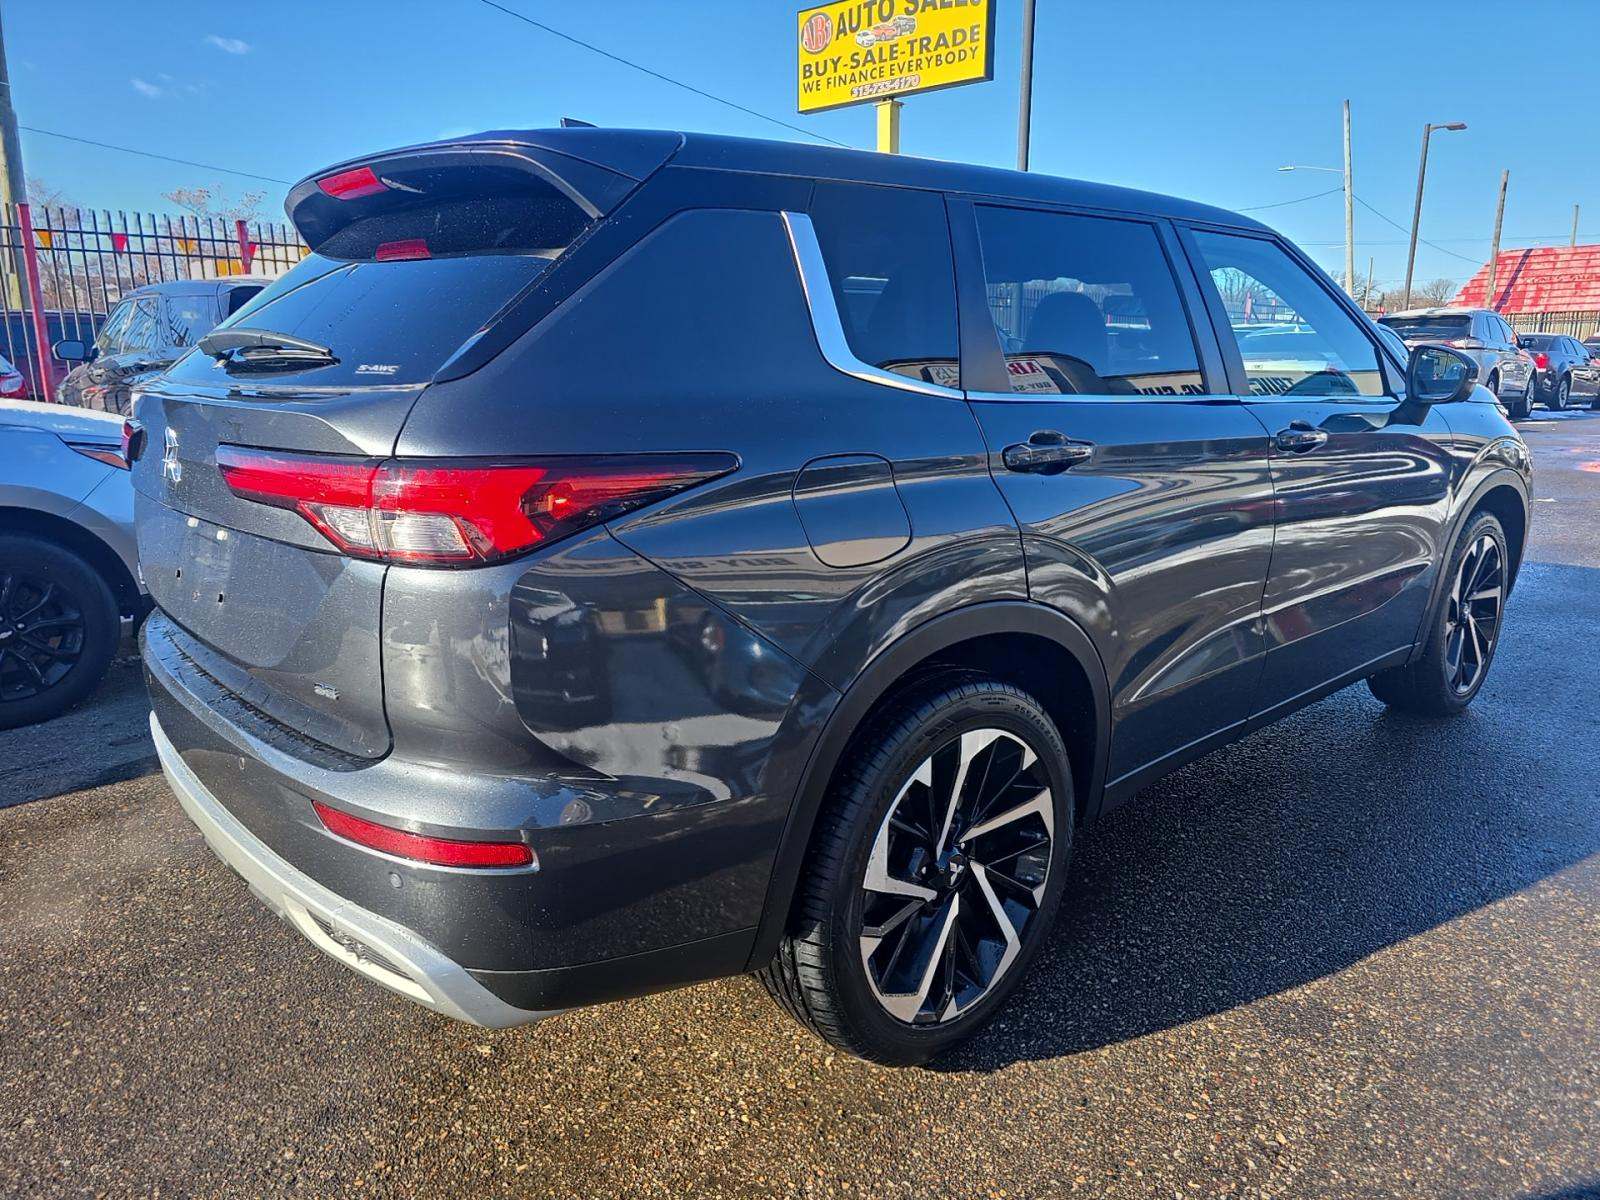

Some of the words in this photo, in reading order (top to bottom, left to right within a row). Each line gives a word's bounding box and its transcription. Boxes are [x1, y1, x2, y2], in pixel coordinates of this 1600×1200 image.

[836, 0, 895, 40] AUTO
[904, 0, 982, 16] SAL
[802, 24, 980, 80] BUY-SALE-TRADE
[803, 80, 821, 93] WE
[826, 67, 884, 89] FINANCE
[889, 46, 979, 76] EVERYBODY
